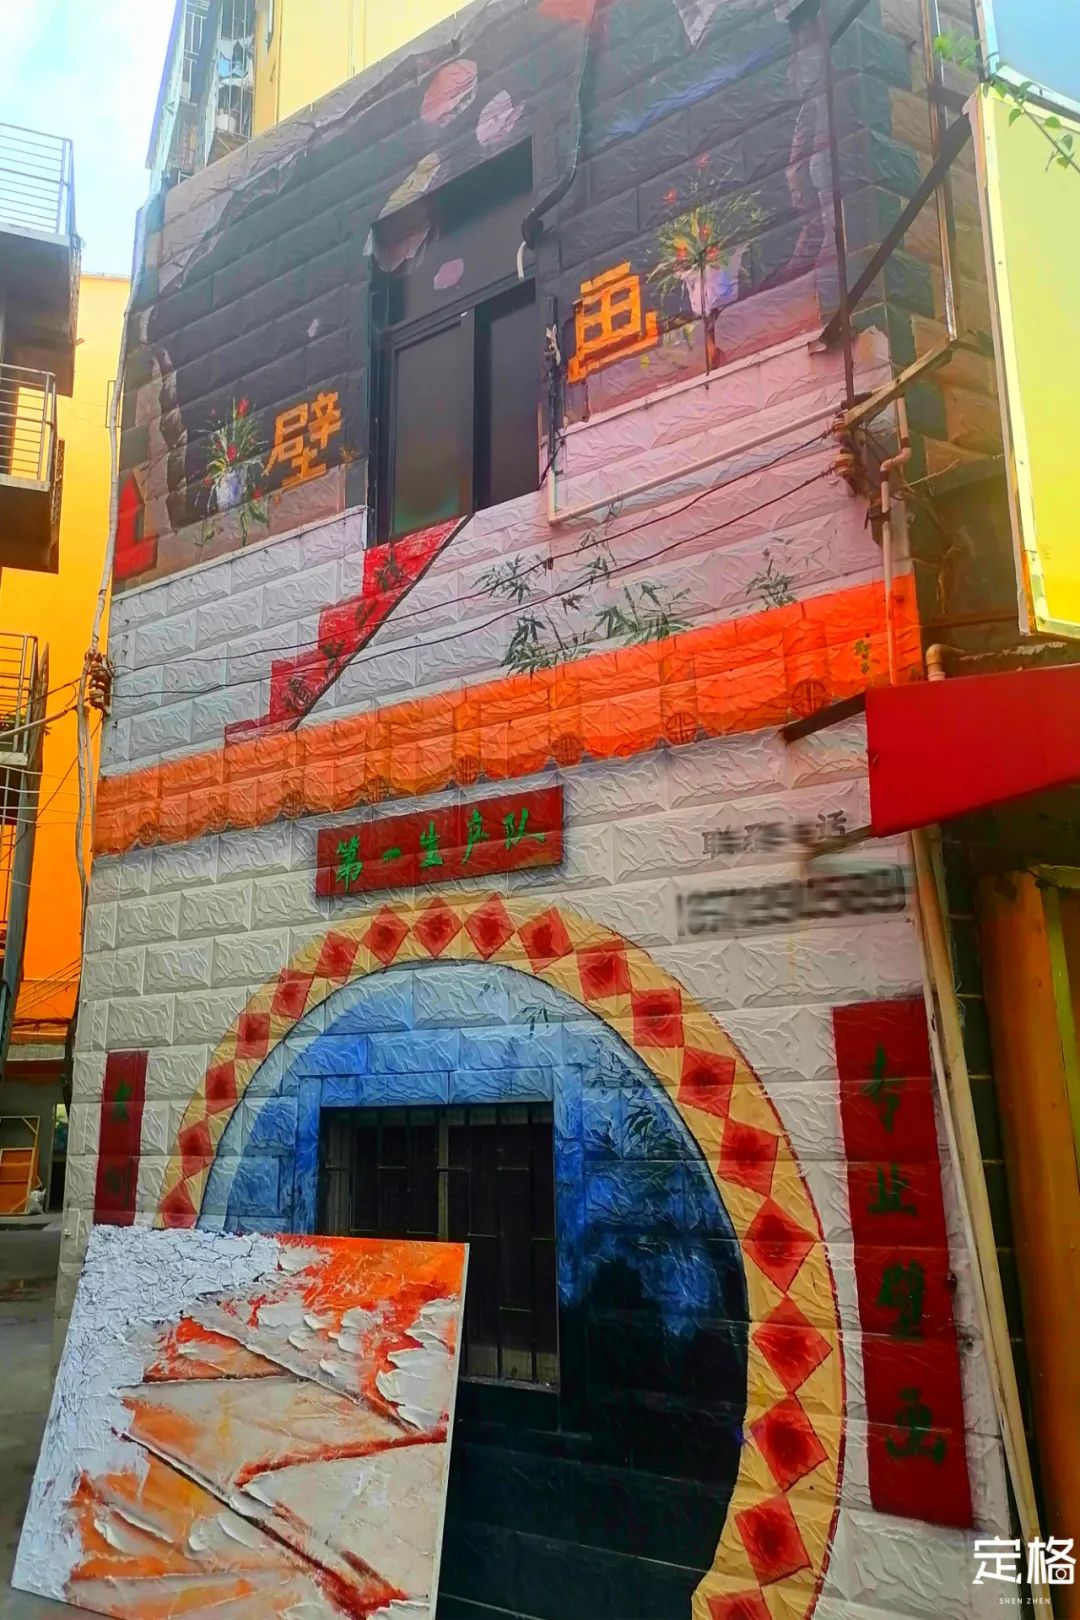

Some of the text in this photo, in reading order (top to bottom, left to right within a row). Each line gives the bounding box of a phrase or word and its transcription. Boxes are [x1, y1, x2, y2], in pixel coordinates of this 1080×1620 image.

[262, 261, 660, 491] 壁 画
[335, 807, 546, 894] 第一生产队
